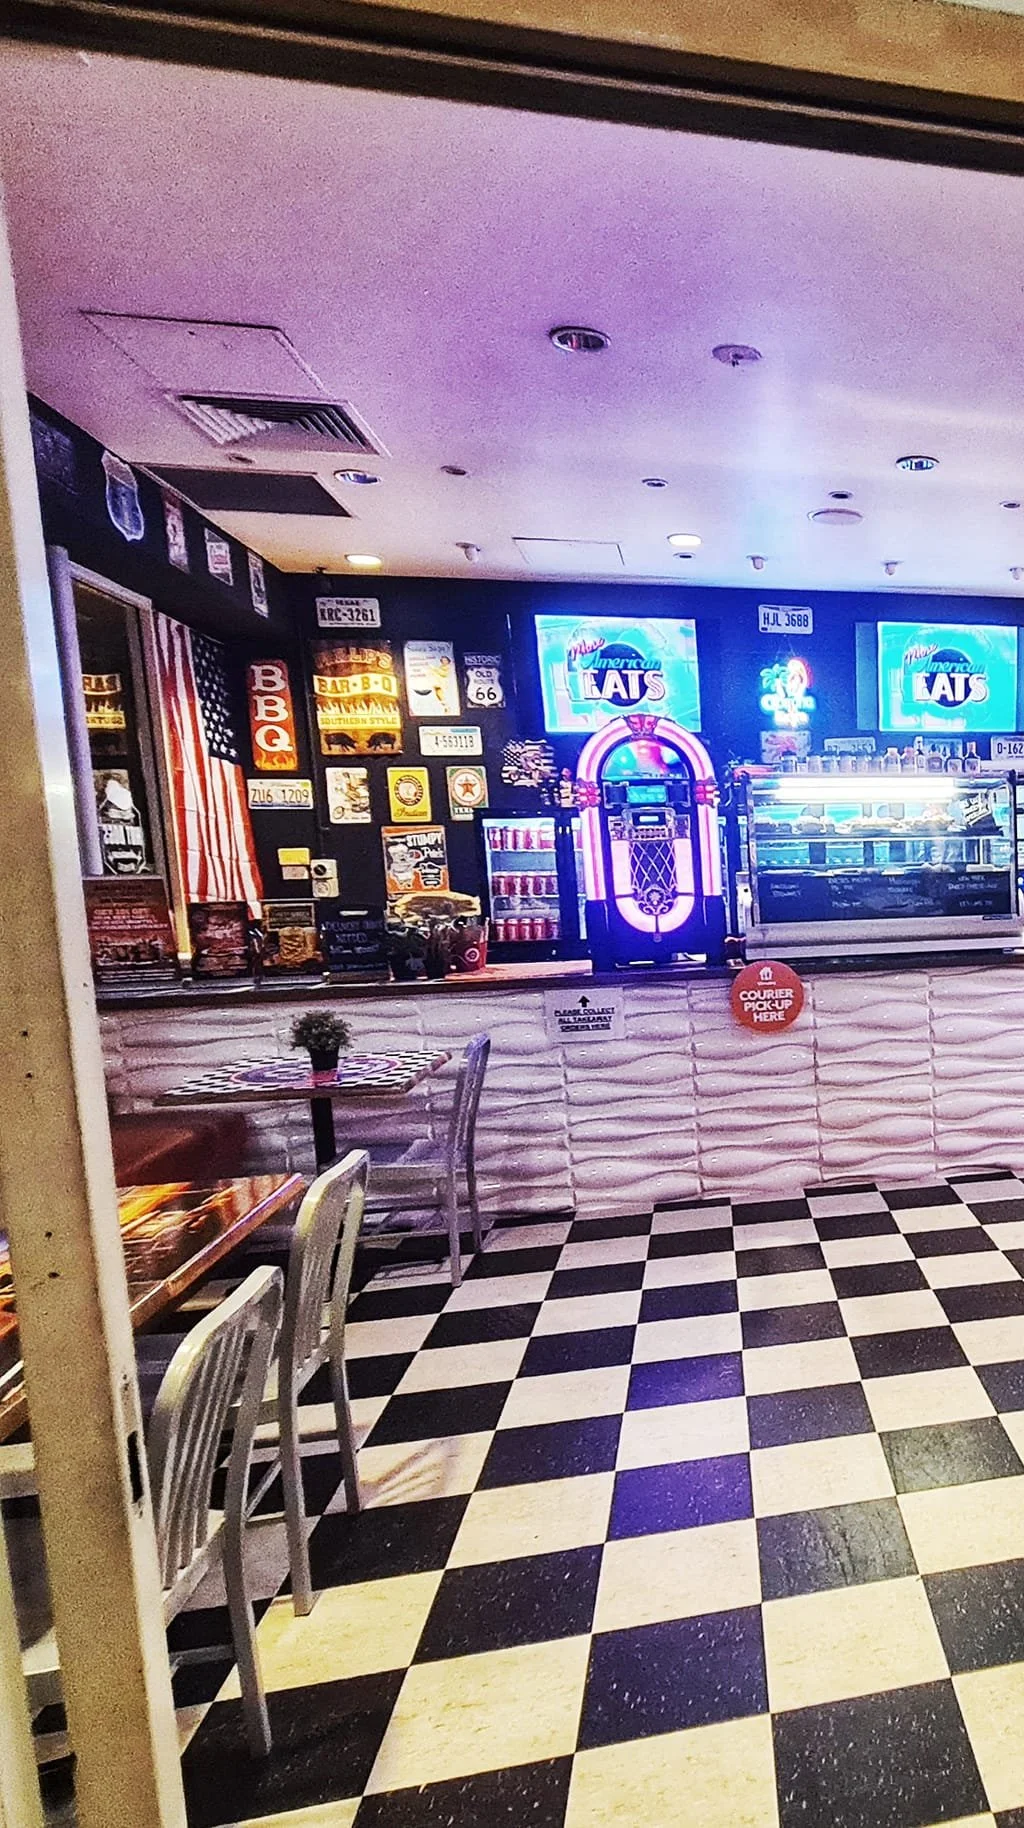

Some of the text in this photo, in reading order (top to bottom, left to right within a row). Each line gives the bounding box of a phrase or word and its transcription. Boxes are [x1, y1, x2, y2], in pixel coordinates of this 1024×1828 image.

[763, 613, 781, 626] HJL
[581, 652, 662, 670] American
[475, 670, 493, 678] OLD
[582, 669, 666, 701] EATS
[915, 672, 987, 702] EATS
[476, 686, 497, 701] 66
[370, 717, 398, 725] STYLE
[739, 988, 794, 1001] COURIER
[554, 1007, 615, 1017] PLEASE COLLECT
[744, 1000, 793, 1012] PICK-UP
[574, 1016, 612, 1024] TAKEAWAY
[753, 1011, 785, 1022] HERE
[592, 1023, 611, 1031] HERE
